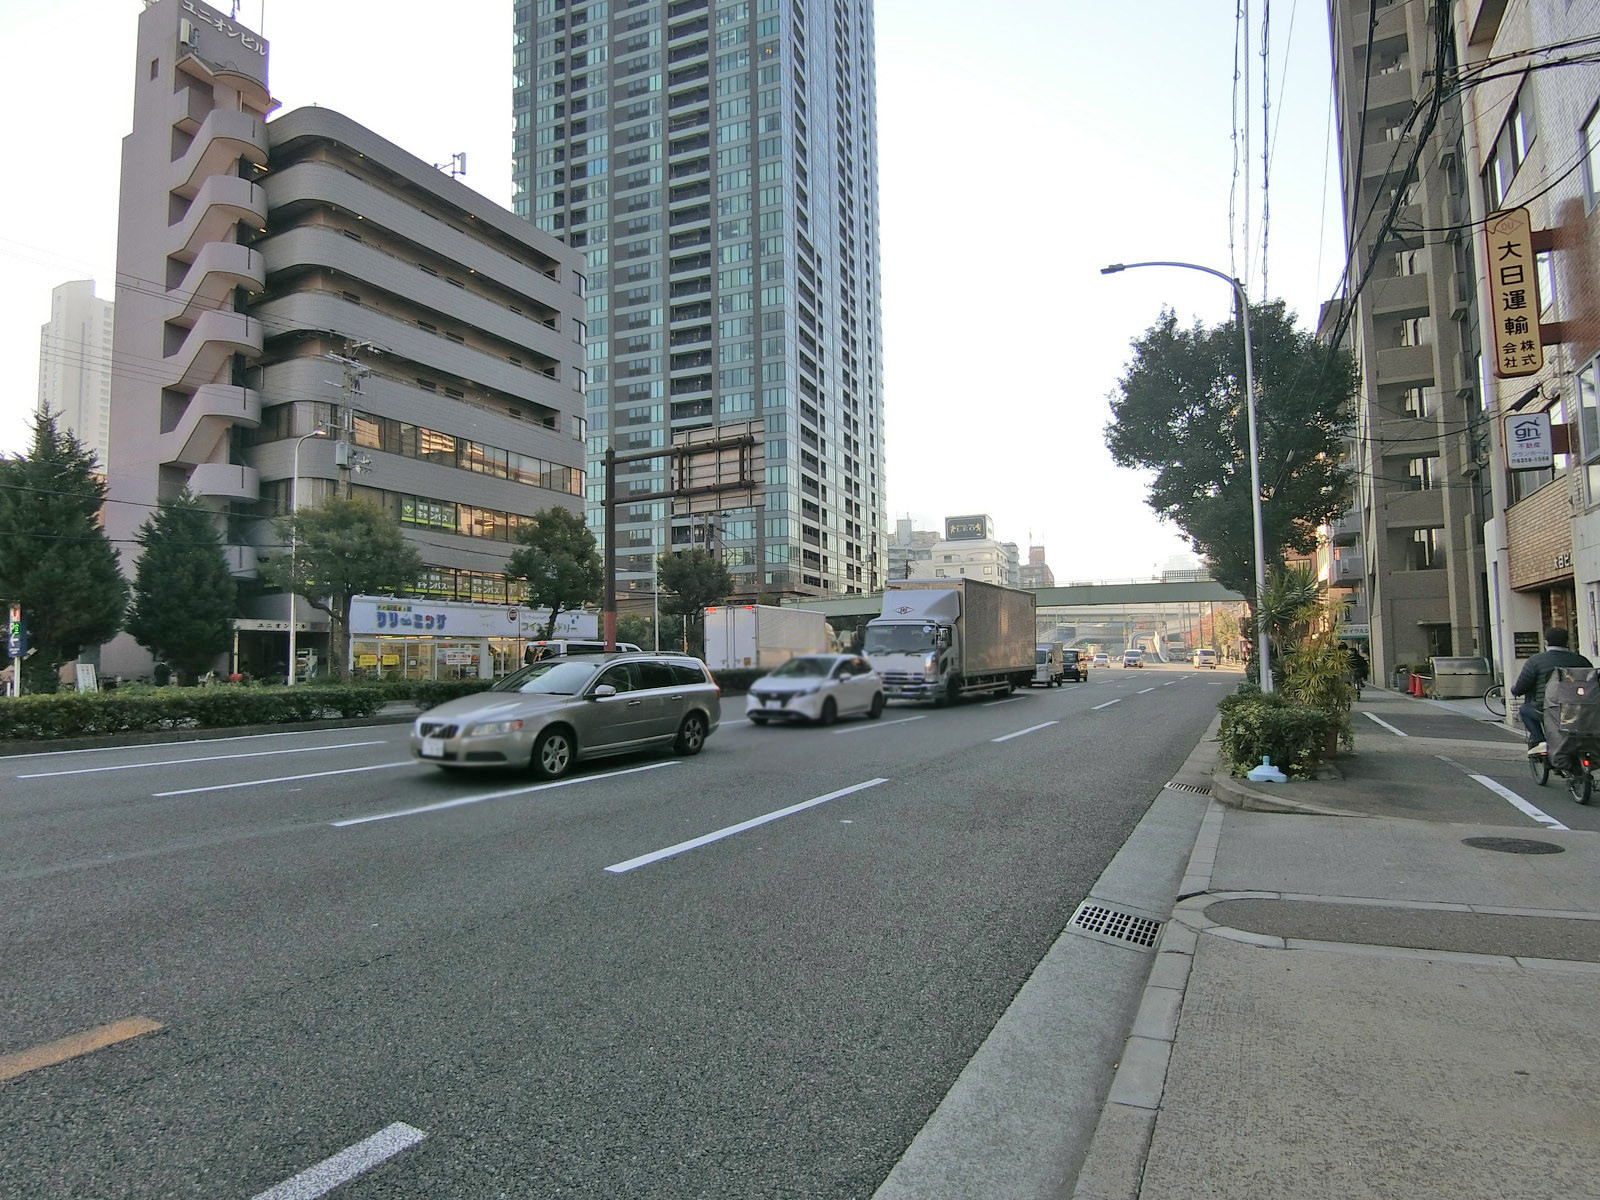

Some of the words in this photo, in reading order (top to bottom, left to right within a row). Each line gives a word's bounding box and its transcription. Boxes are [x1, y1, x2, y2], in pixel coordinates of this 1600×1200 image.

[182, 0, 268, 56] ユニオンビル
[1498, 240, 1529, 336] 大日運輸
[377, 611, 447, 630] クリーニング
